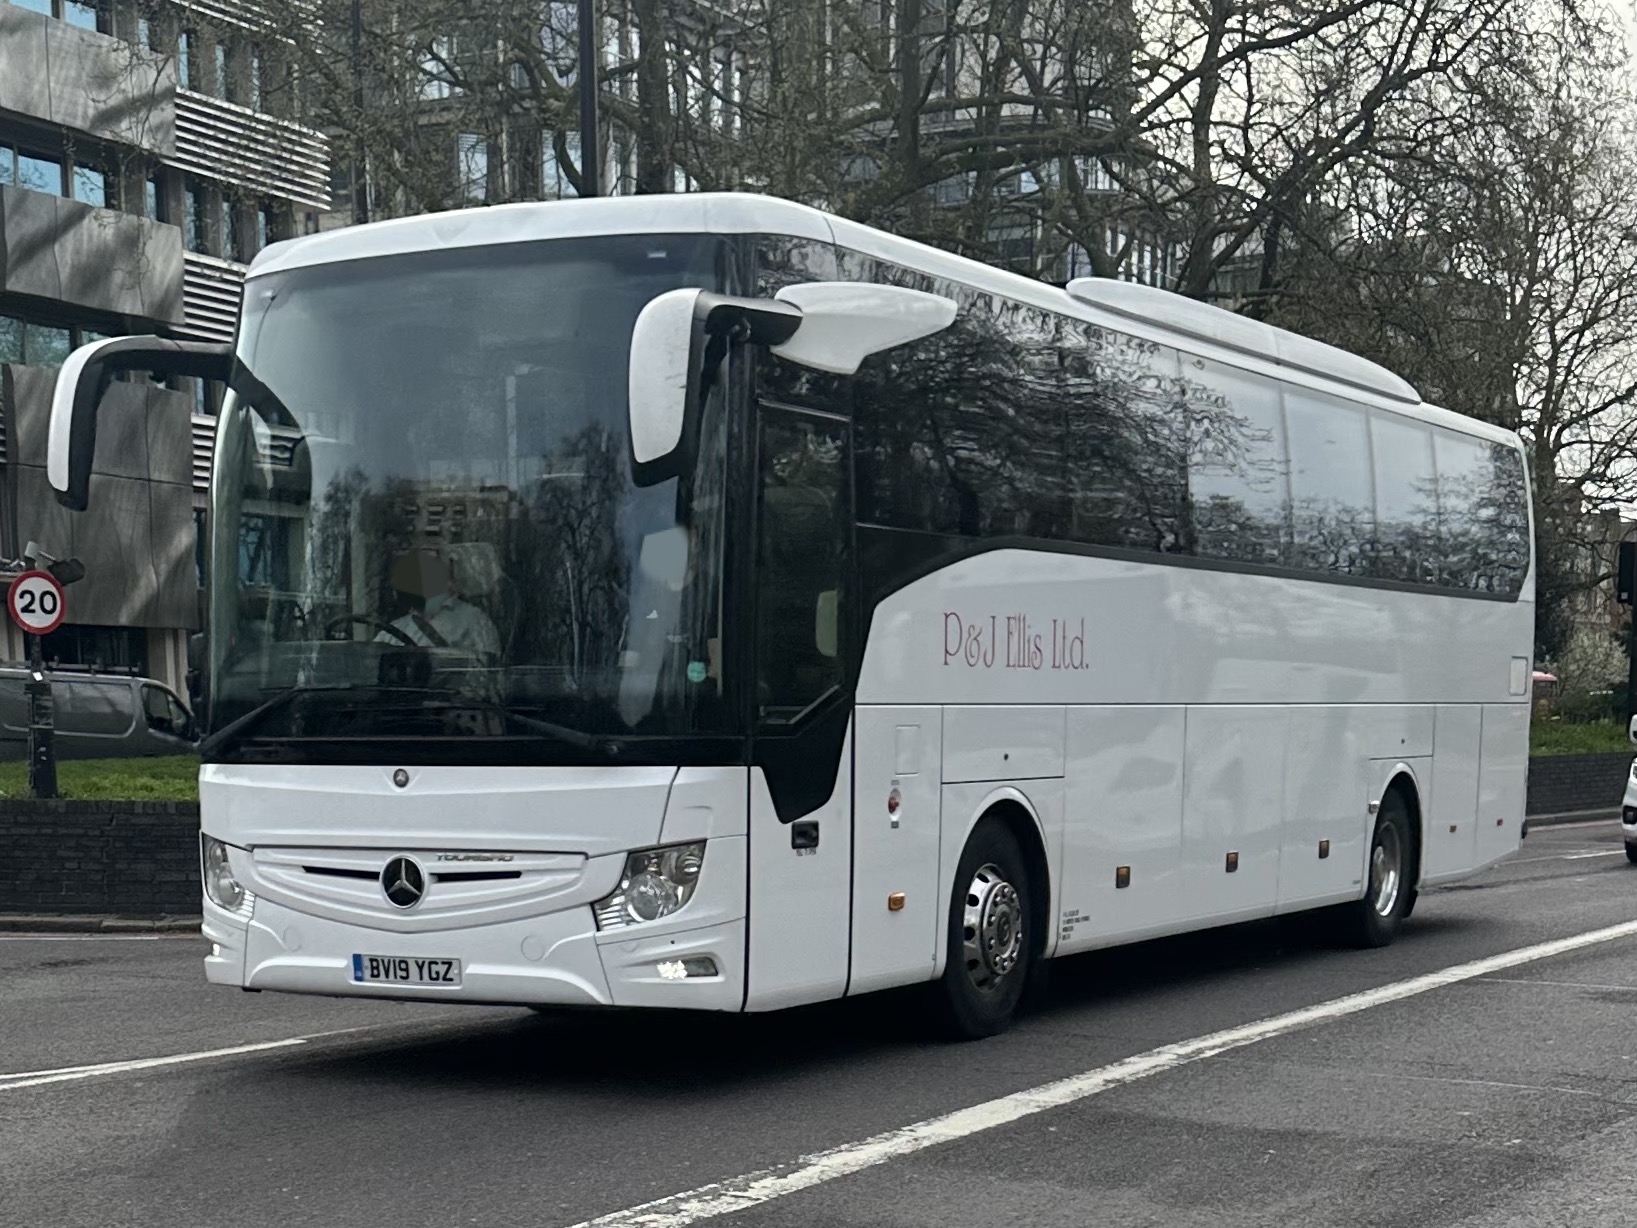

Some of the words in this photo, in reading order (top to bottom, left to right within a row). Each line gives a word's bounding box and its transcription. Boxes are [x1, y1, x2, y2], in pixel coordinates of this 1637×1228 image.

[18, 589, 58, 615] 20
[943, 612, 996, 668] P&J
[1006, 613, 1043, 670] Ellis
[1051, 617, 1089, 669] Ltd.
[369, 958, 410, 980] BV19
[415, 960, 454, 982] YGZ
